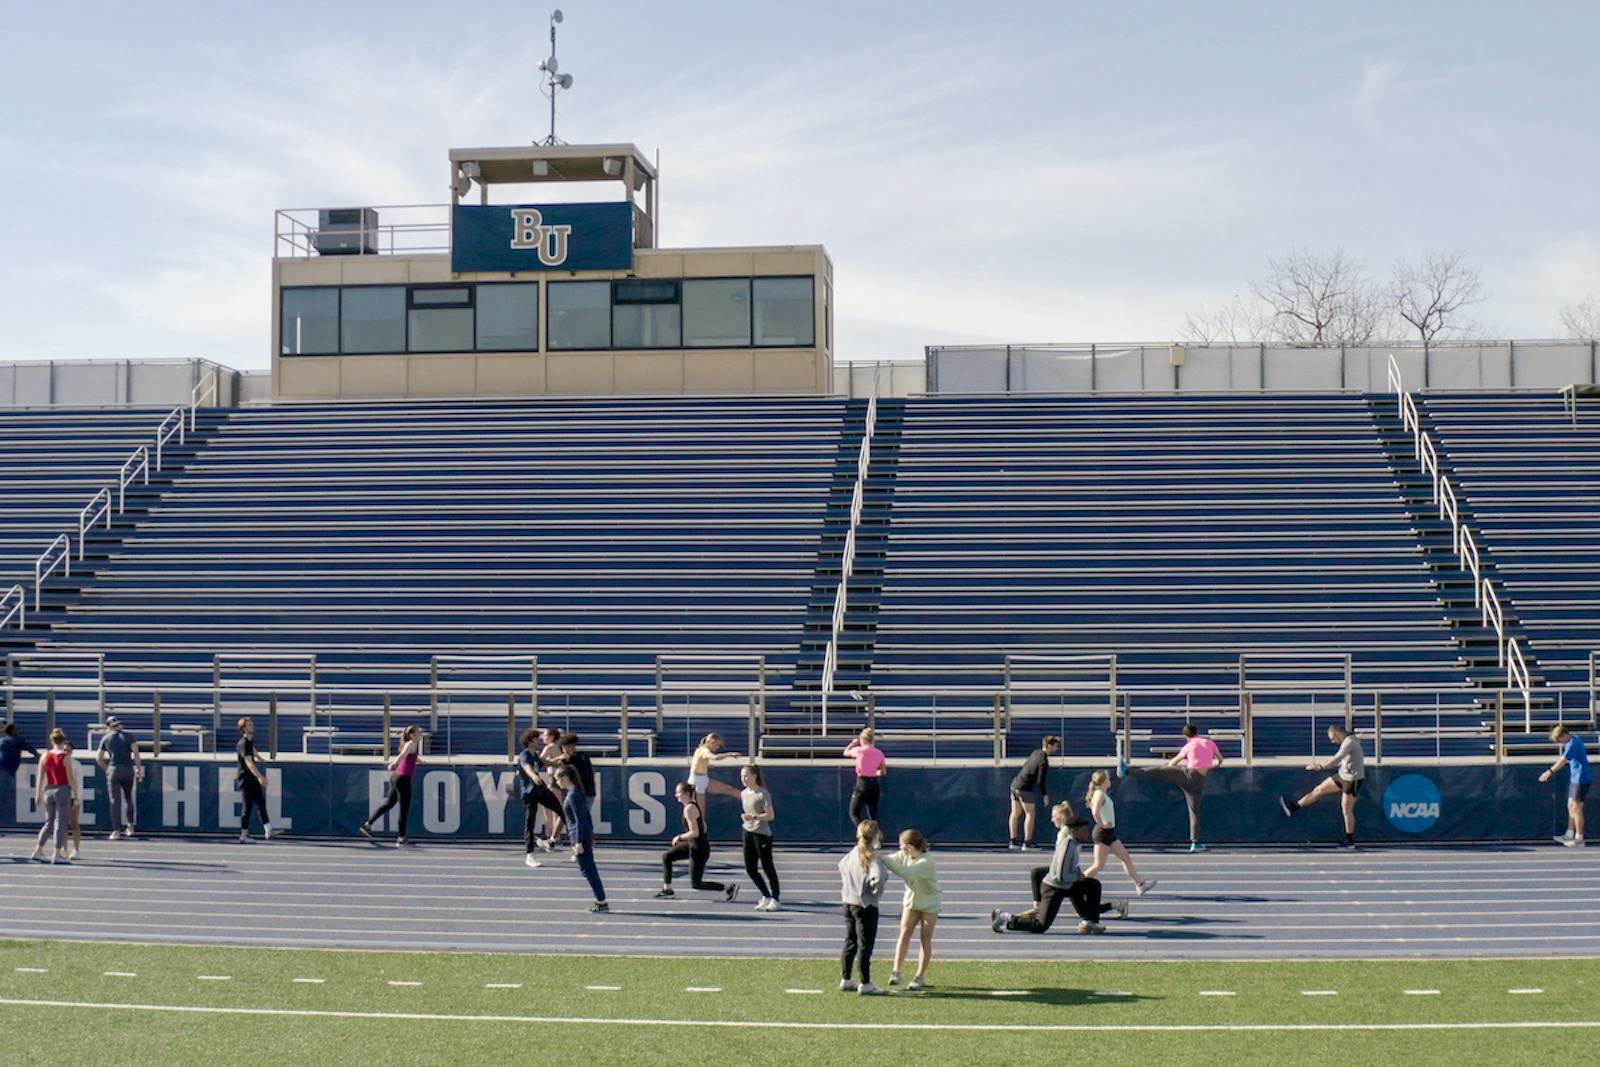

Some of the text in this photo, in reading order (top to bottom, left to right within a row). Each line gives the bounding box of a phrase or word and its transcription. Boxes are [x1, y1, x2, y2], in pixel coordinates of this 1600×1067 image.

[510, 208, 571, 266] BU
[16, 763, 666, 835] BEHEL ROYLS
[1390, 802, 1440, 818] NCAA
